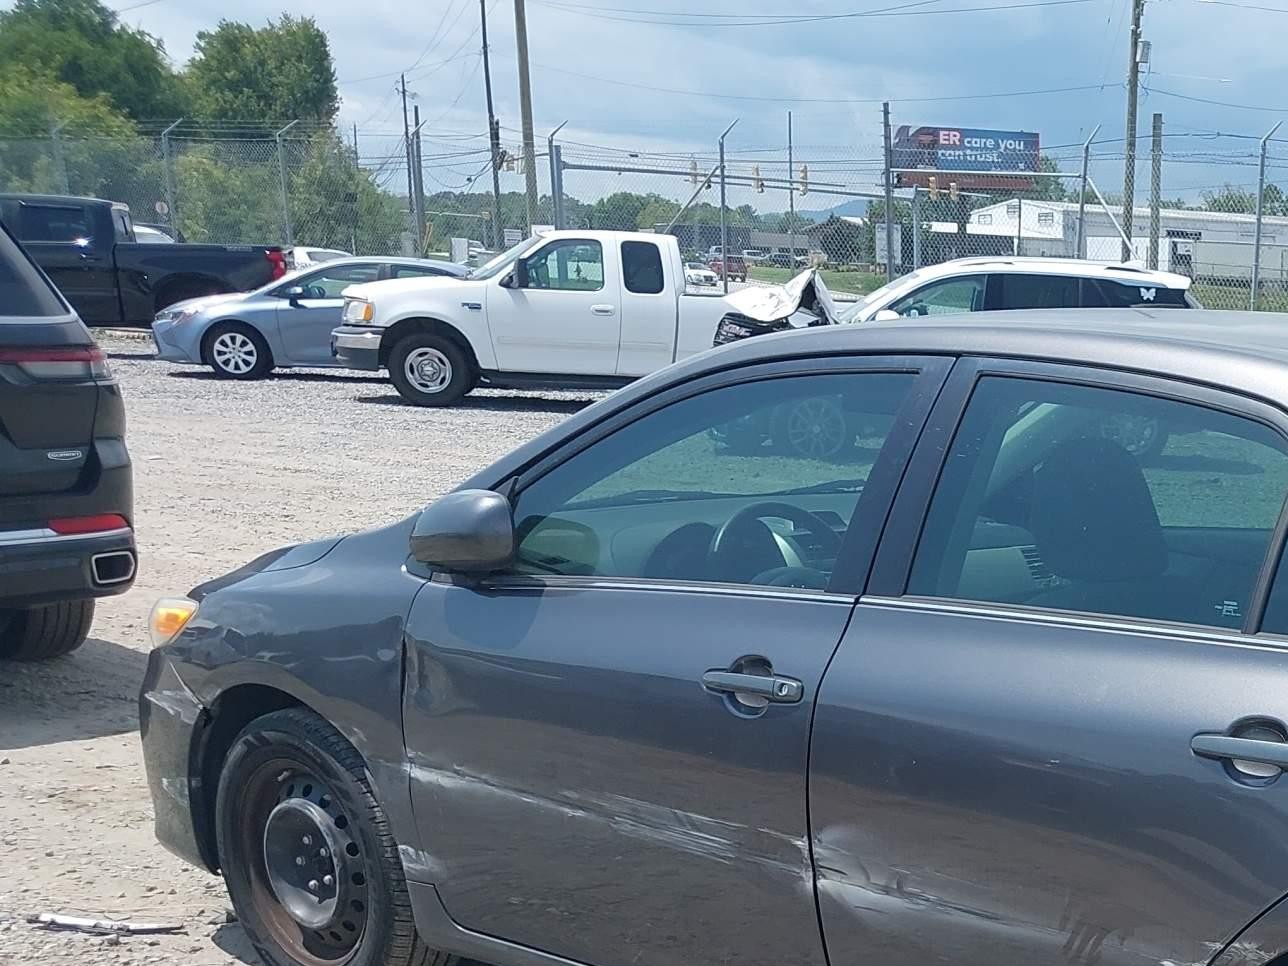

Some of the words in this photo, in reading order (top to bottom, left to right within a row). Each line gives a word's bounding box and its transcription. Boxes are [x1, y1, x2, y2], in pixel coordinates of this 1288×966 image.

[939, 130, 961, 146] ER
[963, 137, 995, 149] care
[998, 139, 1024, 152] you
[938, 150, 964, 161] can
